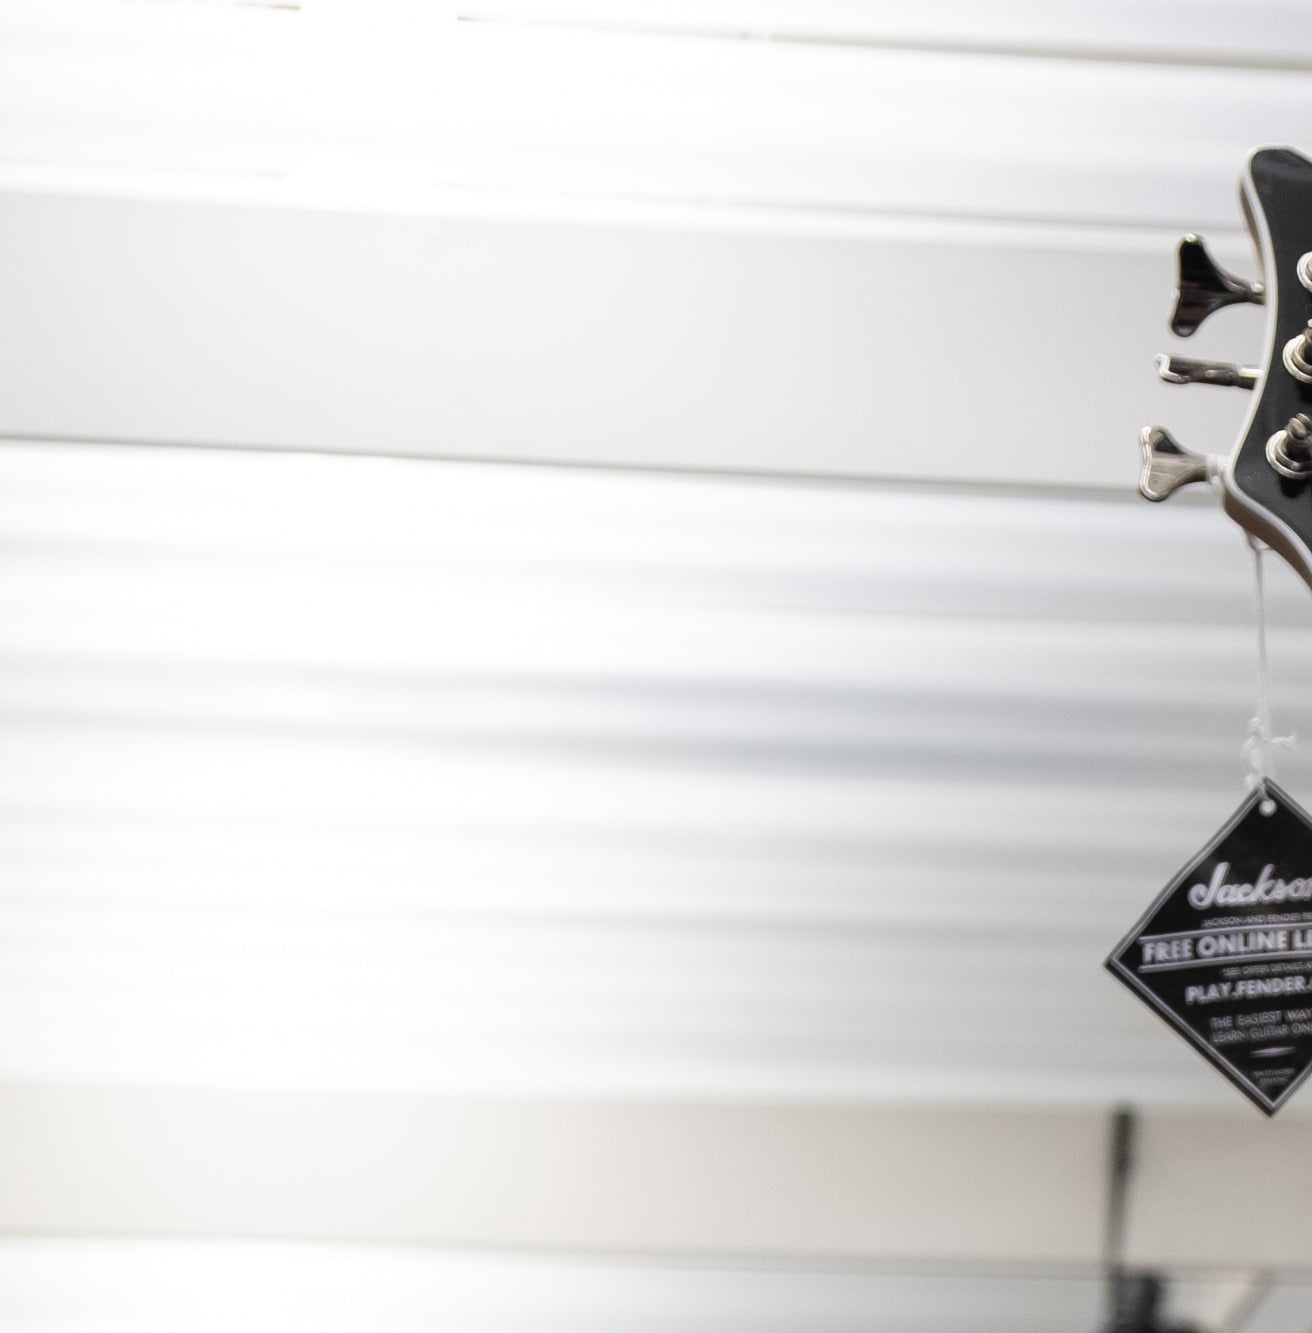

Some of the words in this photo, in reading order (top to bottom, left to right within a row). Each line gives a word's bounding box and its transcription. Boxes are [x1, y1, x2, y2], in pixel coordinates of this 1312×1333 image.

[1142, 938, 1194, 964] FREE
[1196, 930, 1288, 958] ONLINE
[1210, 1015, 1233, 1029] THE
[1236, 1010, 1281, 1026] EASIEST
[1284, 1008, 1312, 1022] WAY
[1211, 1029, 1246, 1045] LEARN
[1249, 1024, 1288, 1039] GUITAR
